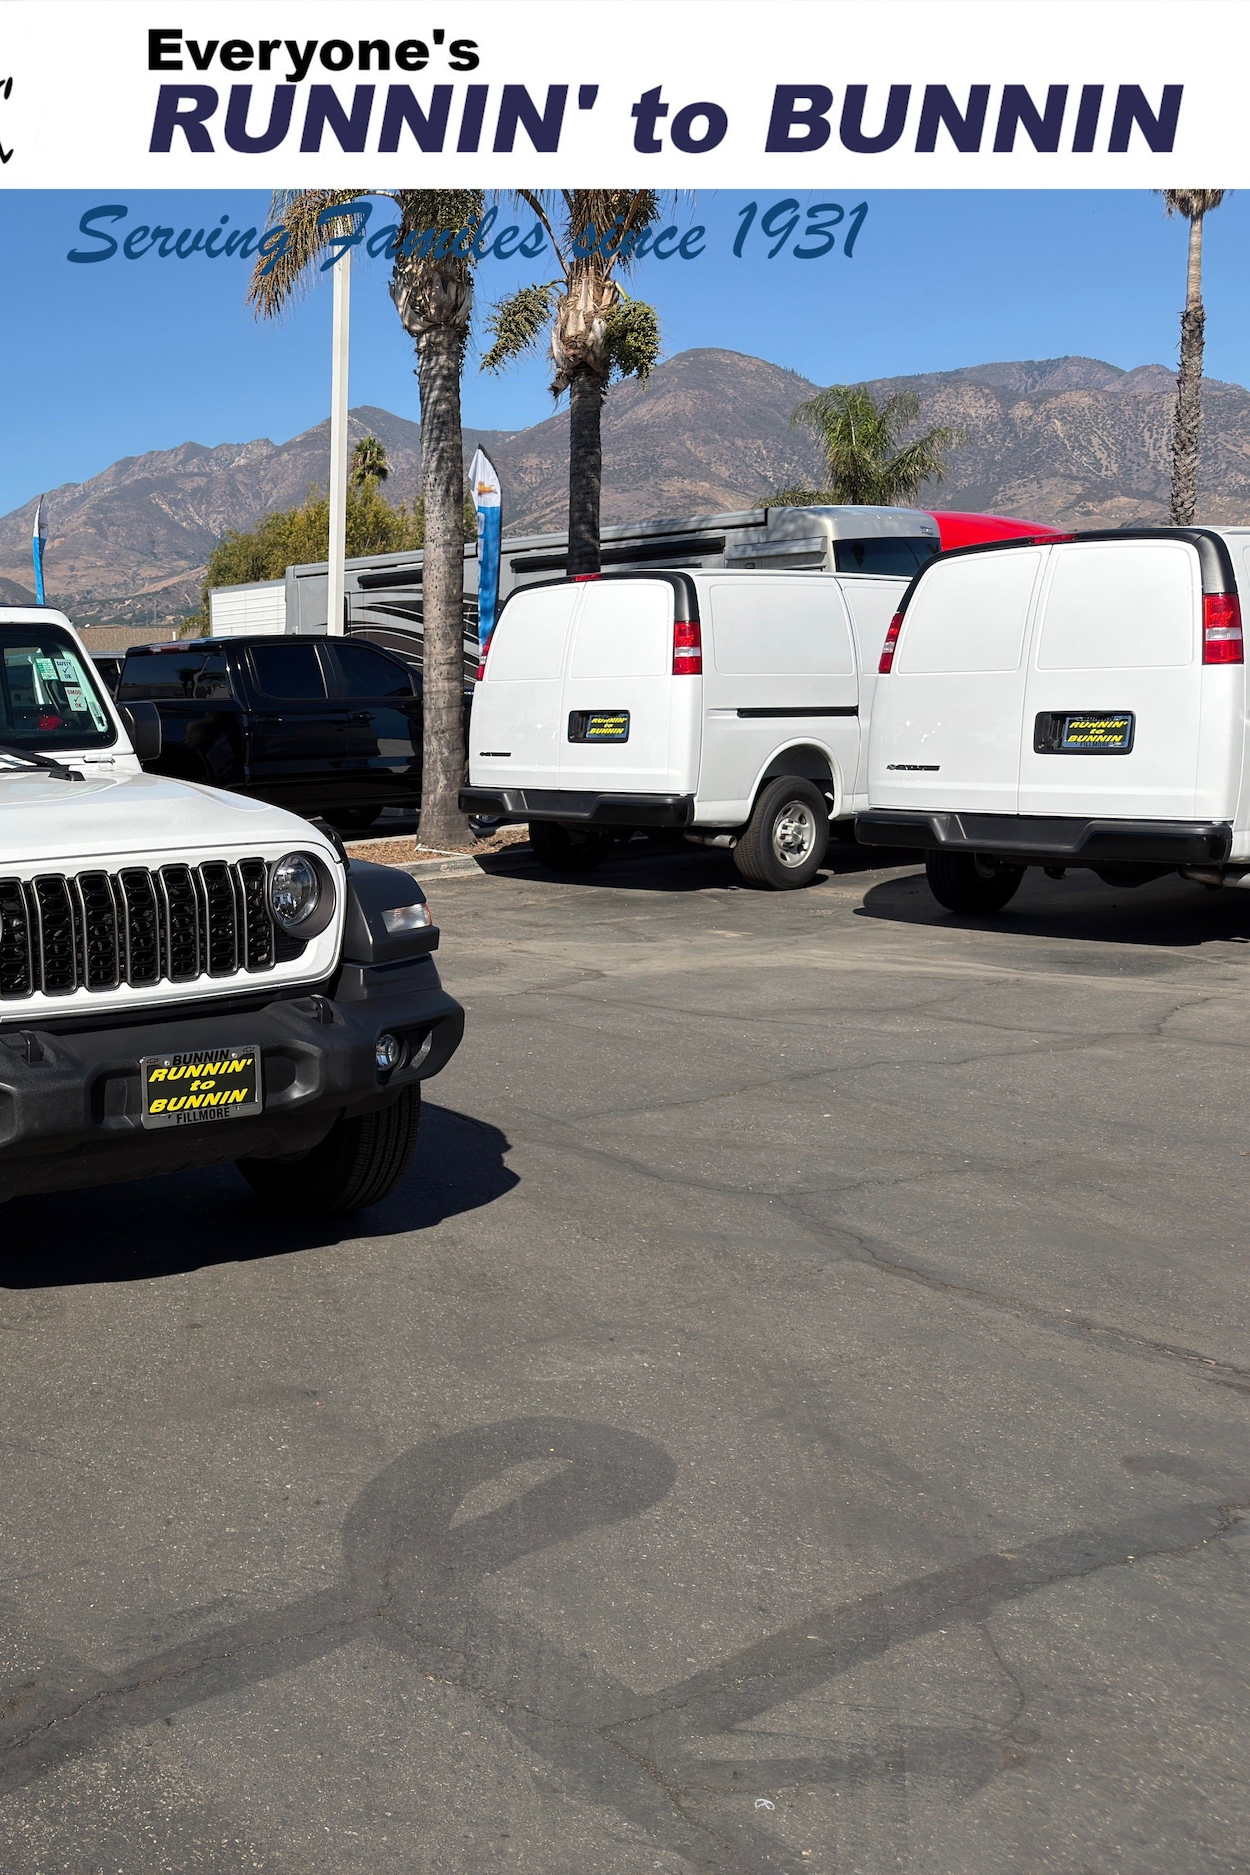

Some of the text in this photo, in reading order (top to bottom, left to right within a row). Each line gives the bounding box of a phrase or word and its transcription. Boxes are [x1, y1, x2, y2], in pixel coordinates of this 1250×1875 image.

[172, 1049, 230, 1066] BUNNIN
[148, 1058, 253, 1083] RUNNIN'
[189, 1079, 216, 1092] to
[149, 1087, 249, 1114] BUNNIN
[176, 1106, 230, 1124] FILLMORE
